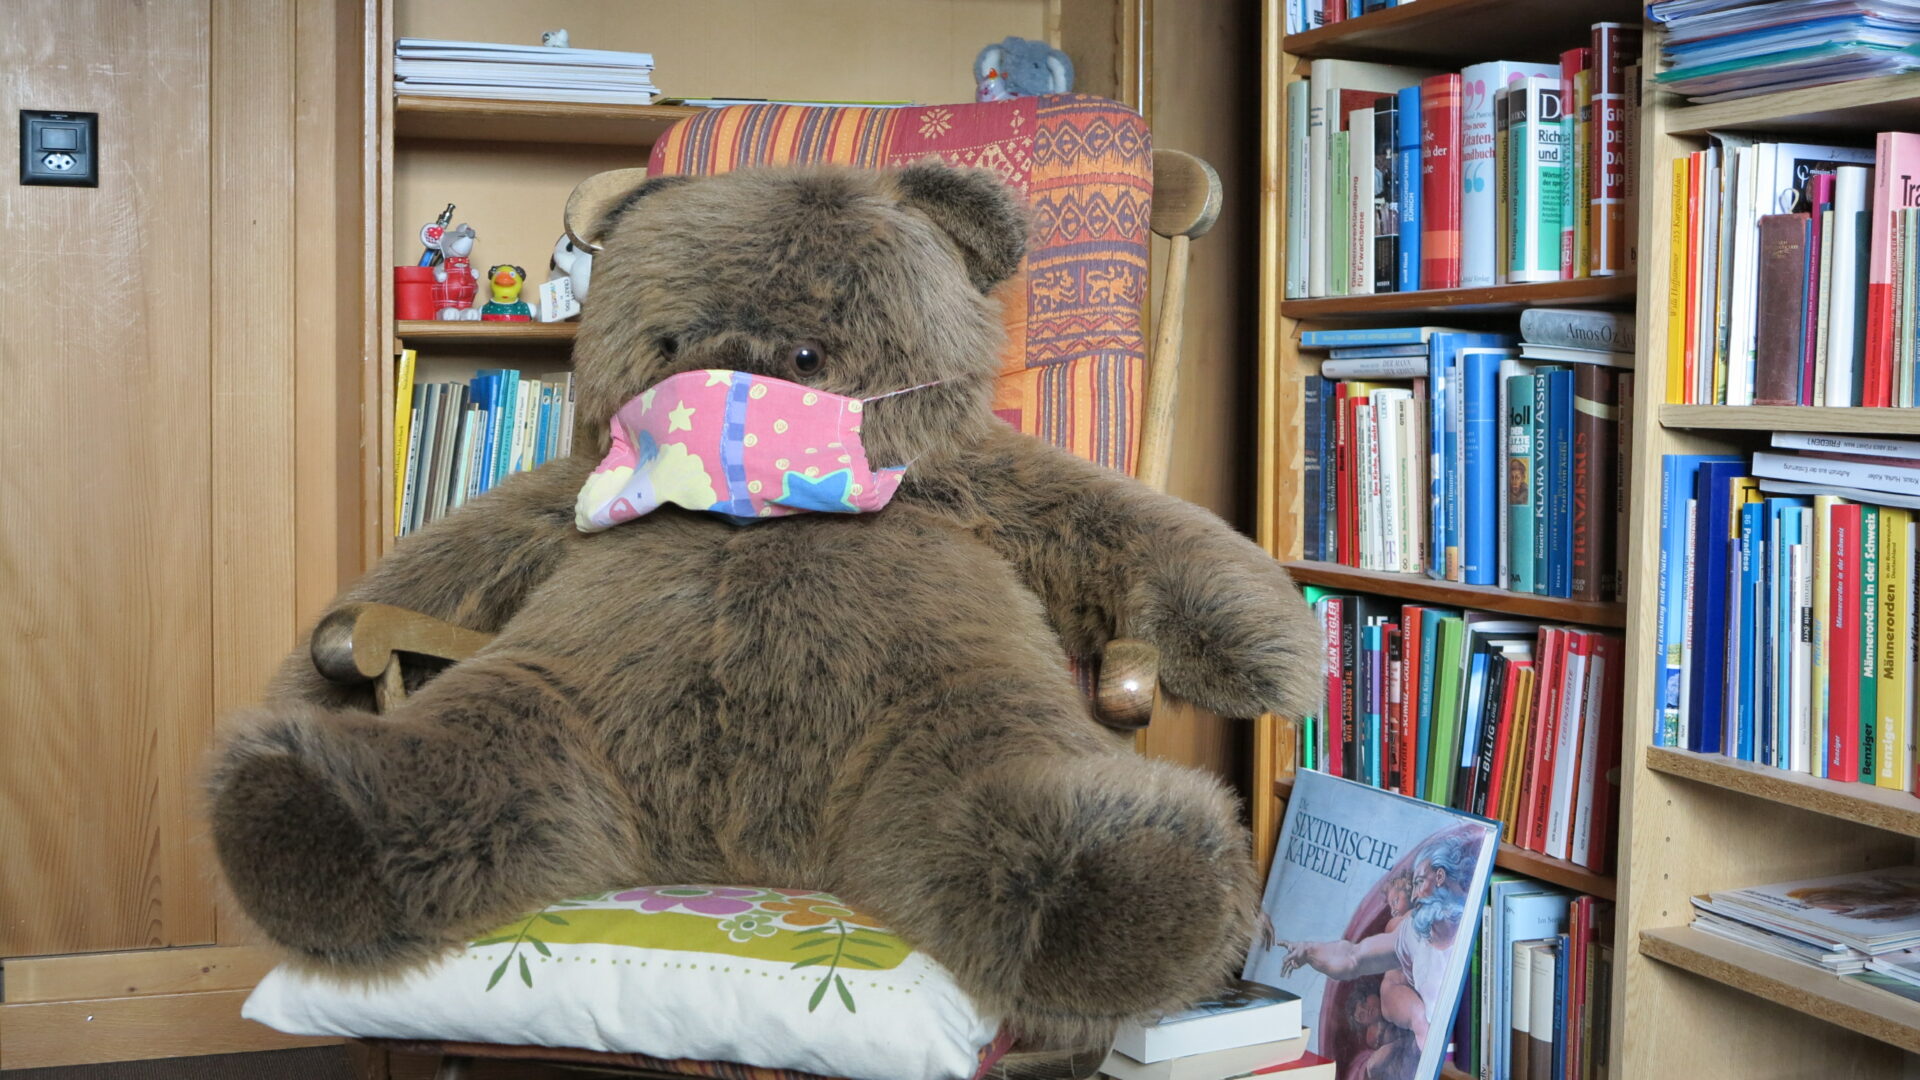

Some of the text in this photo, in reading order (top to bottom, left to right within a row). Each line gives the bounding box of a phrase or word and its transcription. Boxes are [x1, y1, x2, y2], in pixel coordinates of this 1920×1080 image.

[1432, 145, 1447, 157] der
[1538, 148, 1559, 161] und
[1566, 323, 1599, 341] Amos
[1535, 373, 1545, 518] KLARA VON ASSISI
[1574, 432, 1587, 567] FRANZISKUS
[1837, 527, 1845, 557] Schweiz
[1835, 581, 1843, 629] Männerorden
[1864, 513, 1875, 678] Männerorden in der Schweiz
[1328, 602, 1337, 677] JEAN ZIEGLER
[1883, 584, 1895, 680] Männerorden
[1560, 668, 1574, 746] LEBENSWERTE
[1482, 725, 1495, 773] BILLIG
[1862, 723, 1874, 776] Benziger
[1882, 716, 1896, 780] Benziger
[1284, 835, 1352, 884] KAPELLE
[1291, 811, 1399, 873] SIXTINISCHE
